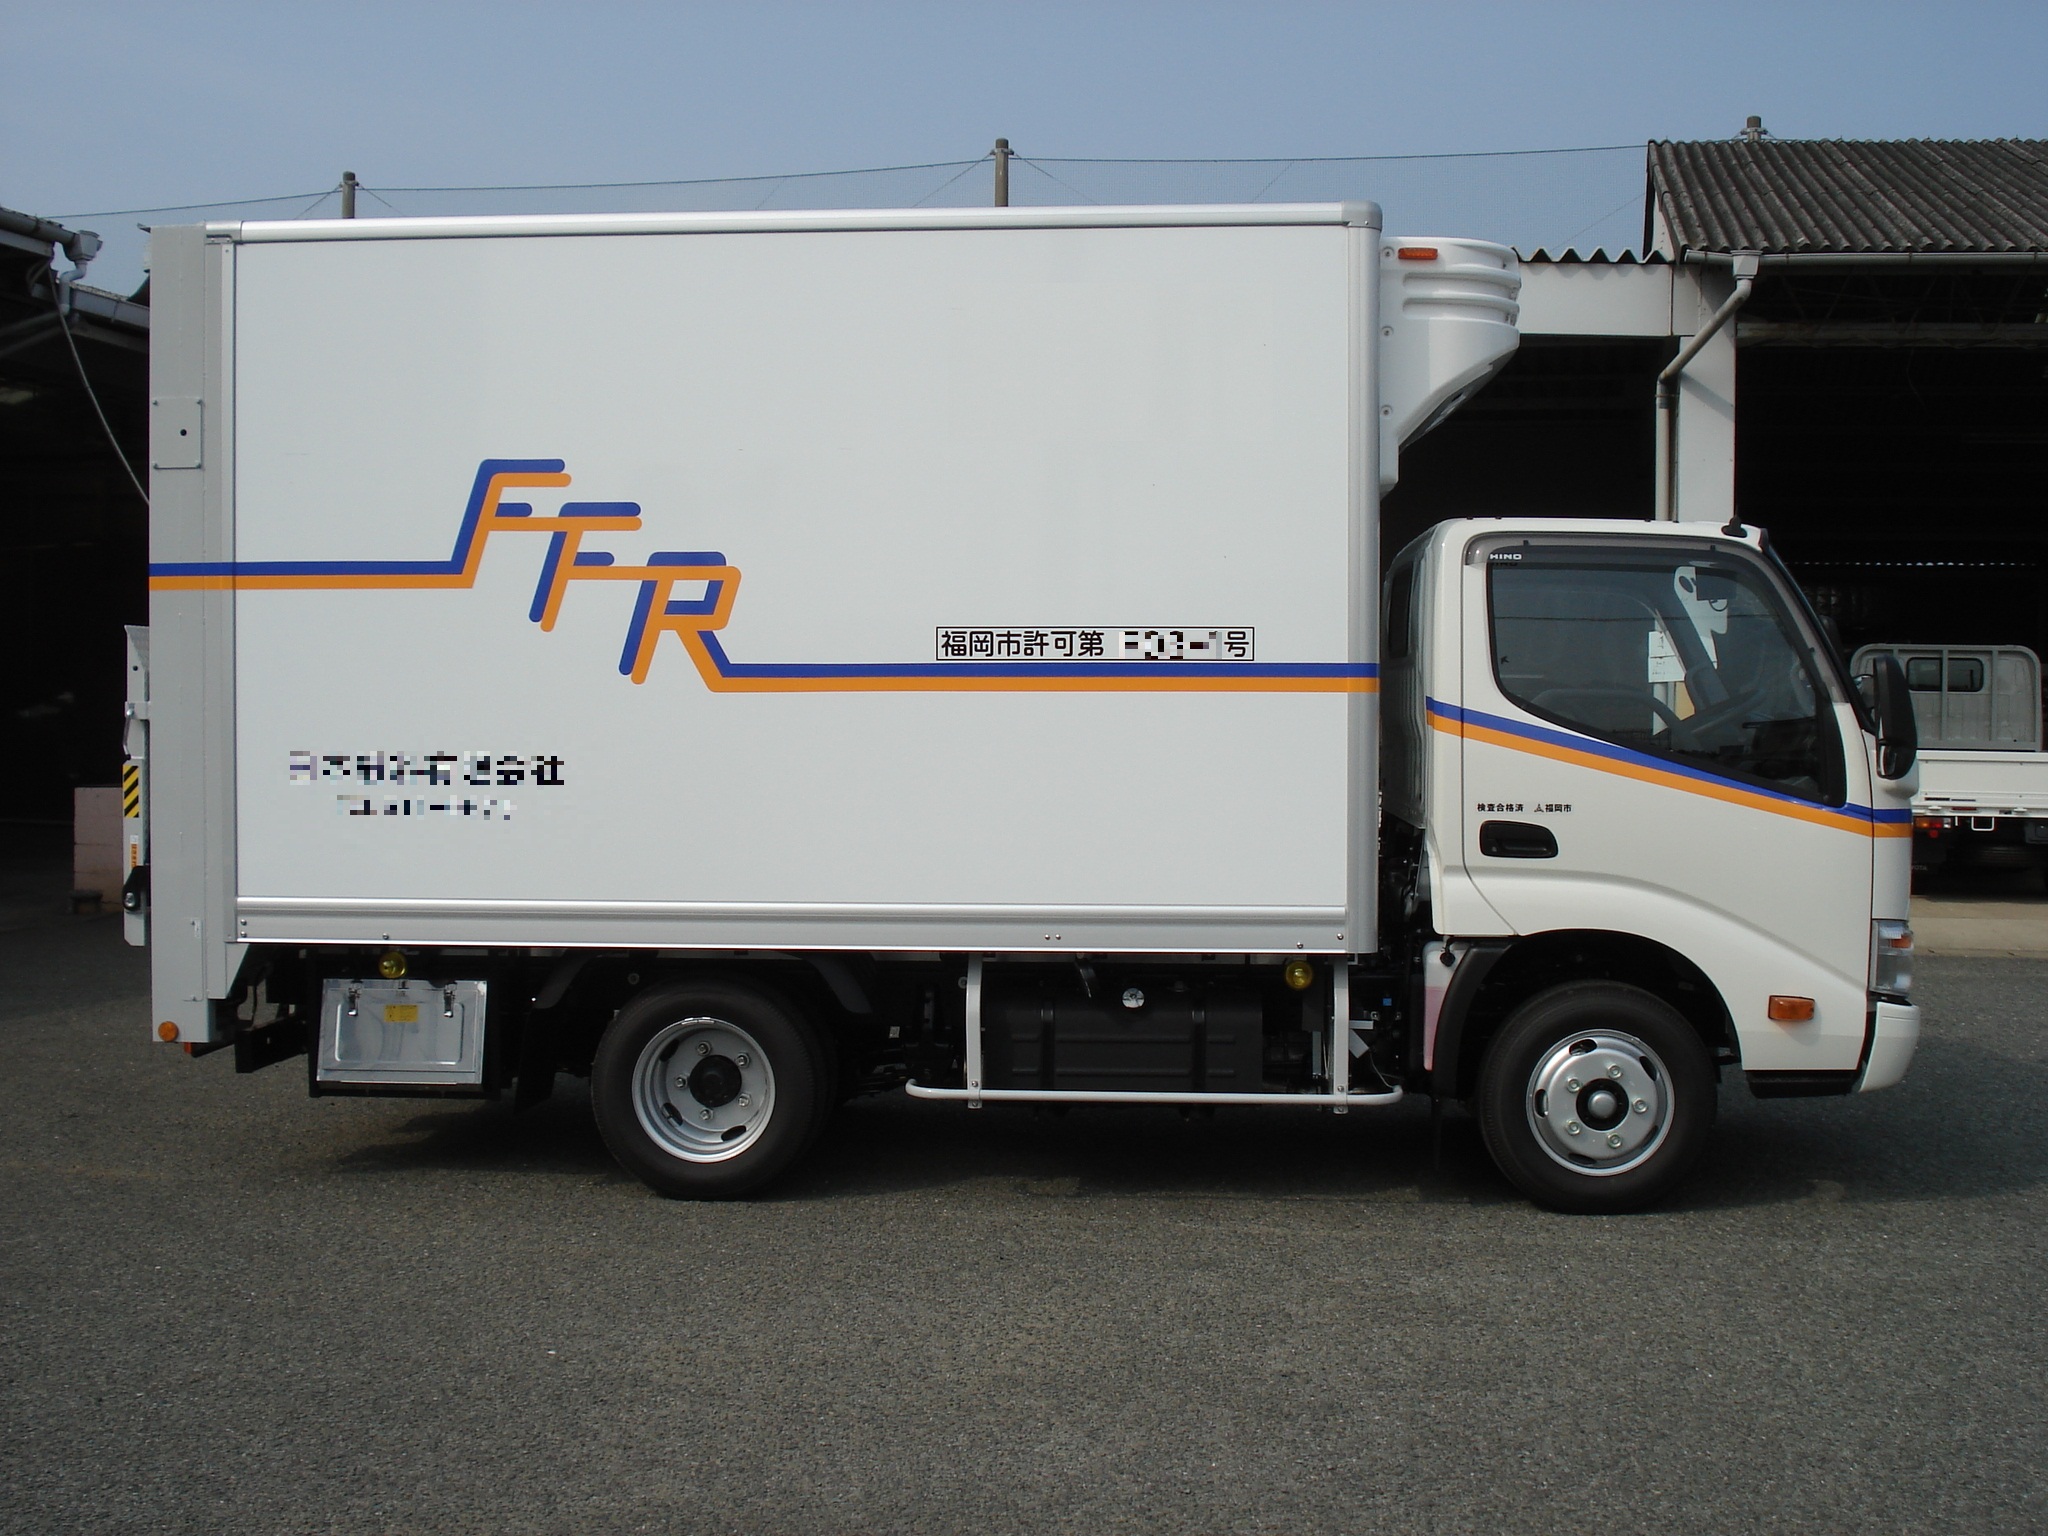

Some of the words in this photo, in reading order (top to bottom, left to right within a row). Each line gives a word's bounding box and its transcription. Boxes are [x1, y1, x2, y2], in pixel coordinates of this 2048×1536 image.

[940, 630, 1105, 658] 福岡市許可第
[1477, 803, 1524, 813] 検査合格済
[1545, 803, 1572, 813] 福岡市
